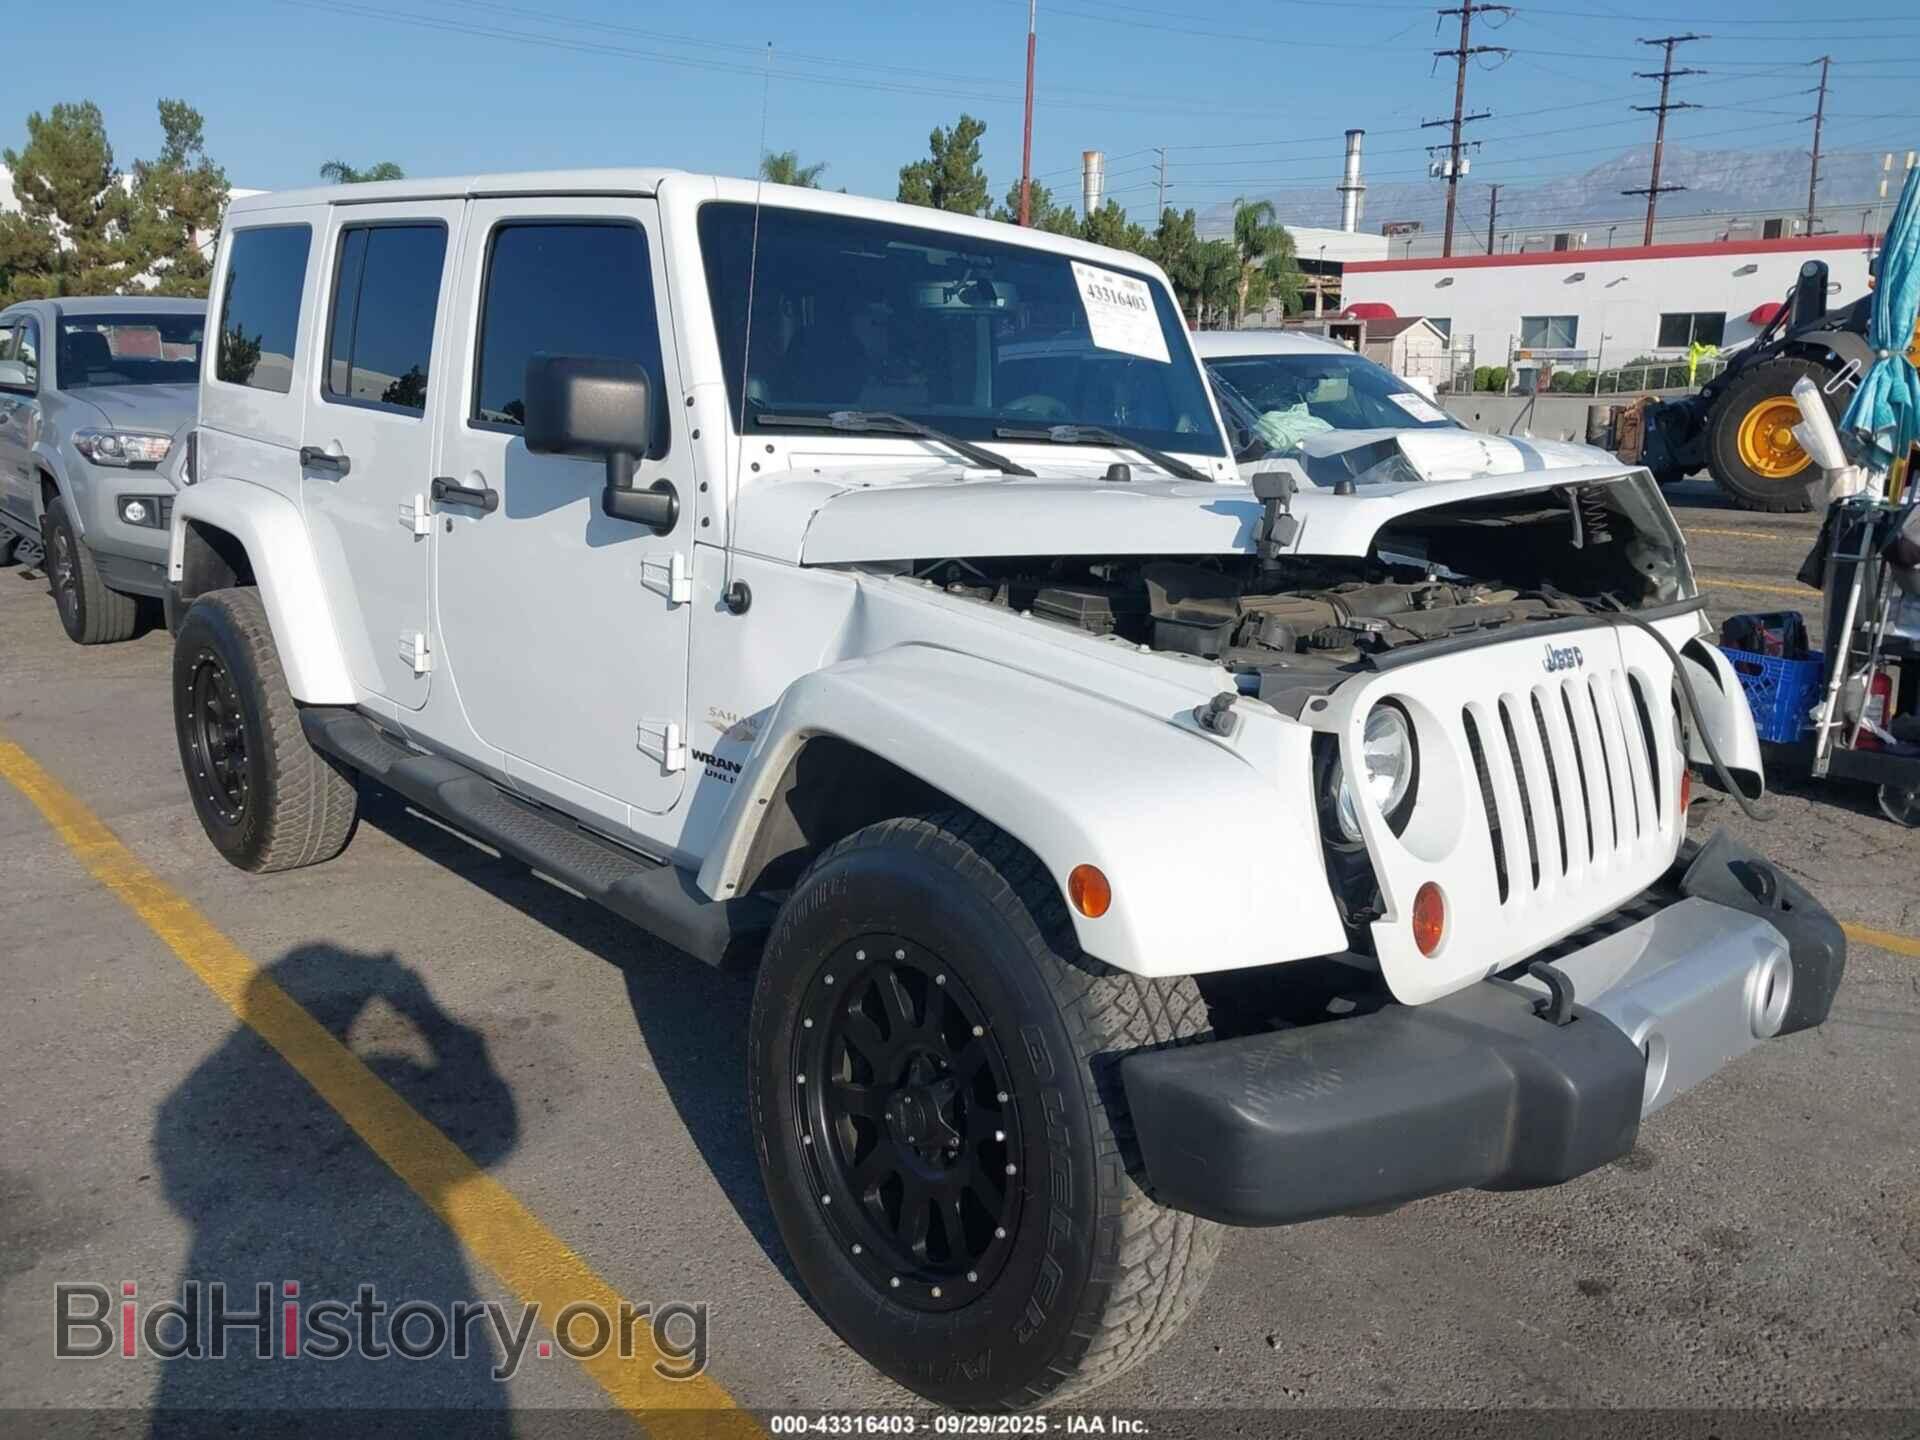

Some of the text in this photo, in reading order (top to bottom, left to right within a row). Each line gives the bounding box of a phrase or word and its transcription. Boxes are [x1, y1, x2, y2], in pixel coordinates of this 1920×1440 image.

[1087, 283, 1148, 312] 43316403
[1542, 642, 1584, 673] Jeep
[691, 748, 743, 774] WRAN
[704, 767, 737, 784] UNLI
